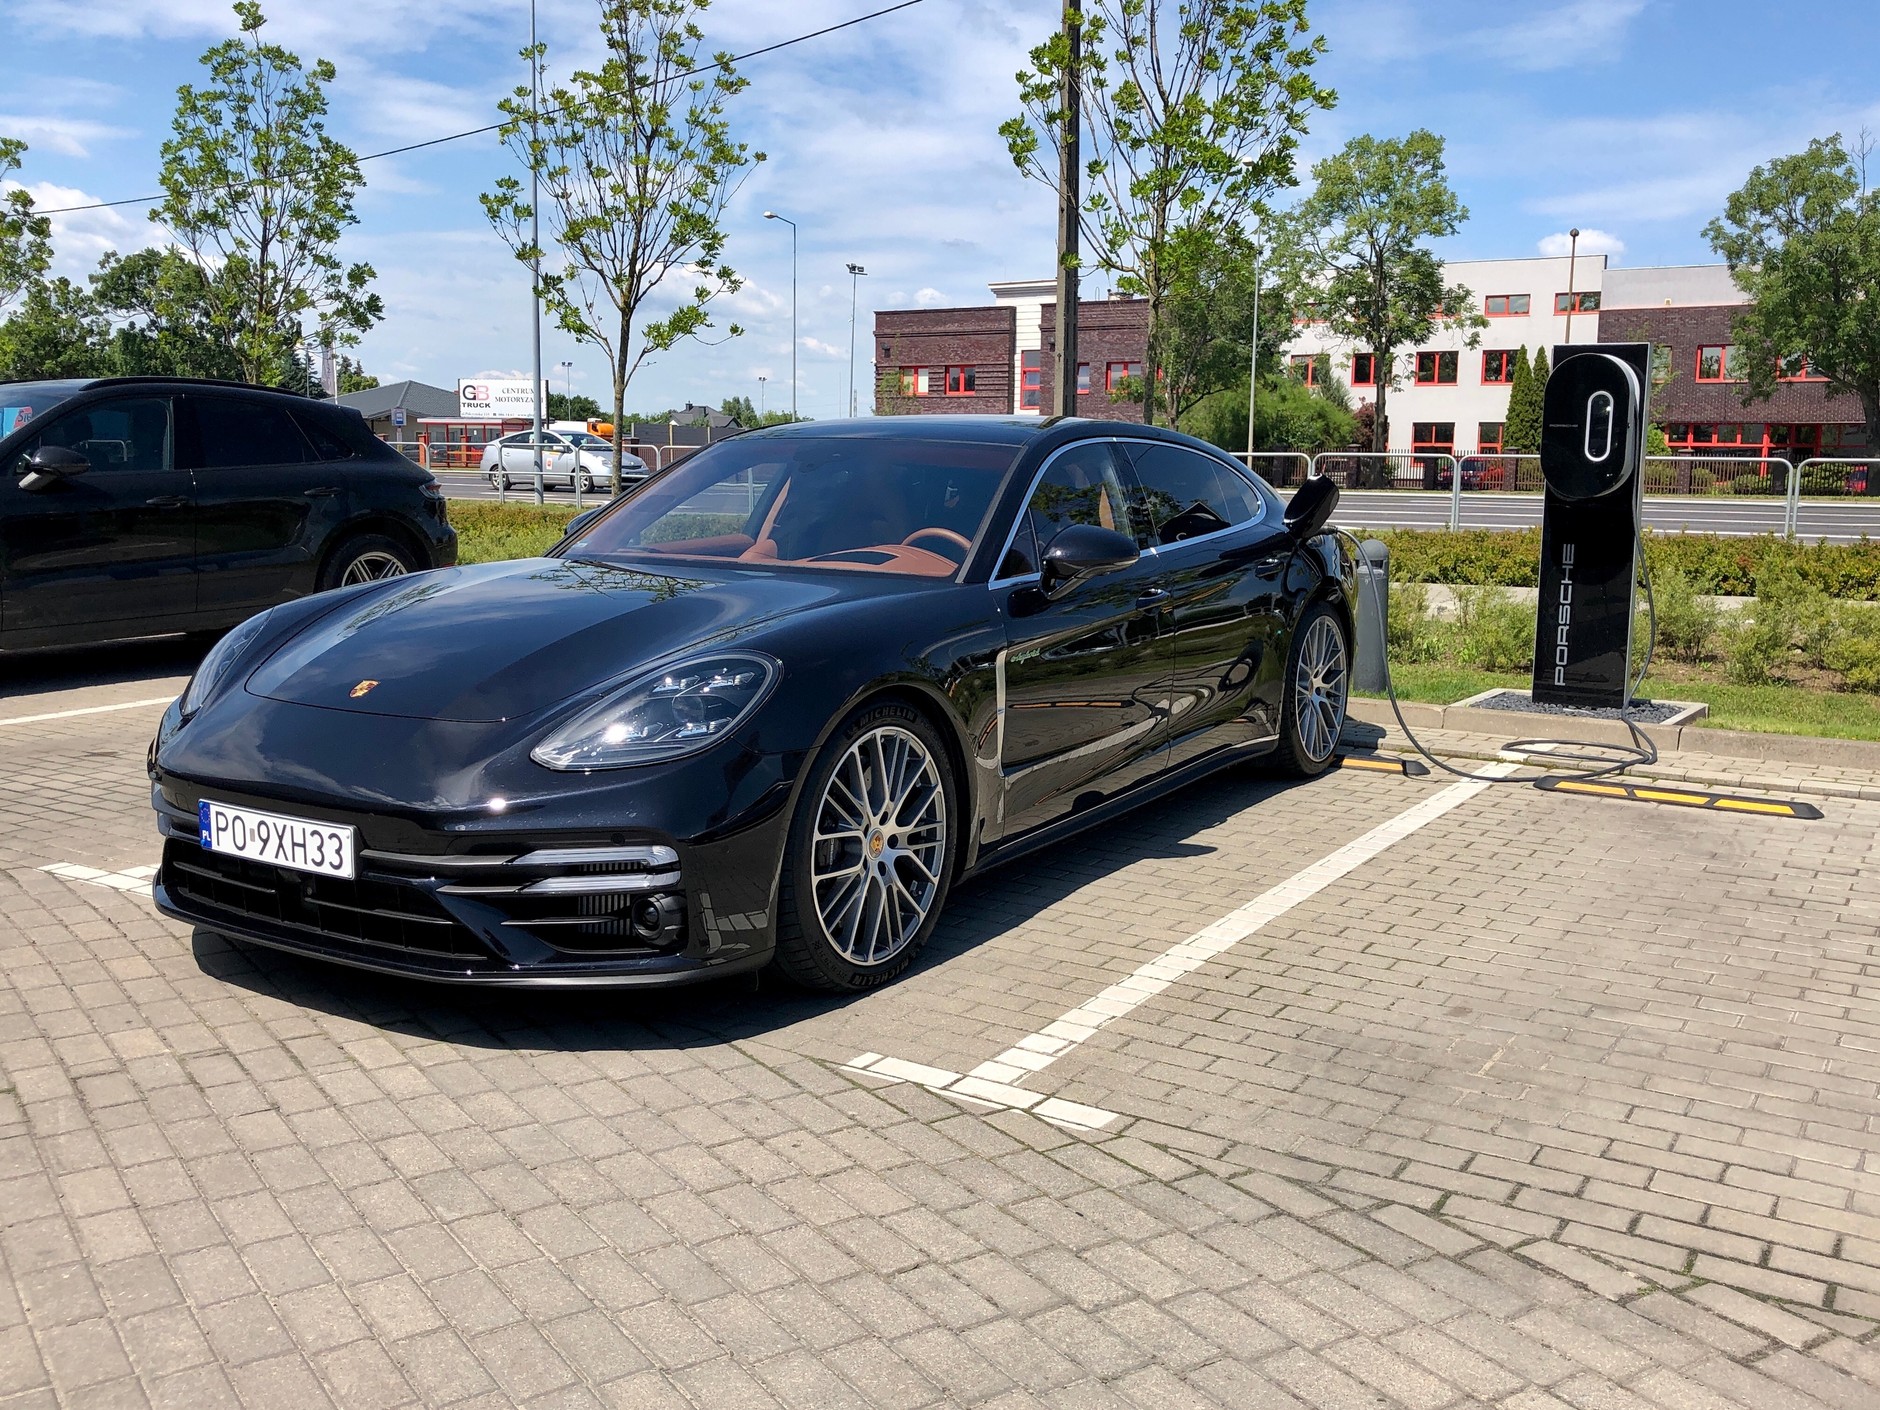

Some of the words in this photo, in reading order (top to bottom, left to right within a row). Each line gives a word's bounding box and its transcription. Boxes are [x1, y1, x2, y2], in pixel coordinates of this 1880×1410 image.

[463, 384, 490, 401] GB
[1554, 543, 1575, 686] PORSCHE
[860, 706, 916, 727] MICHELIN
[202, 829, 211, 842] PL
[215, 810, 247, 851] PO
[257, 820, 344, 871] 9XH33
